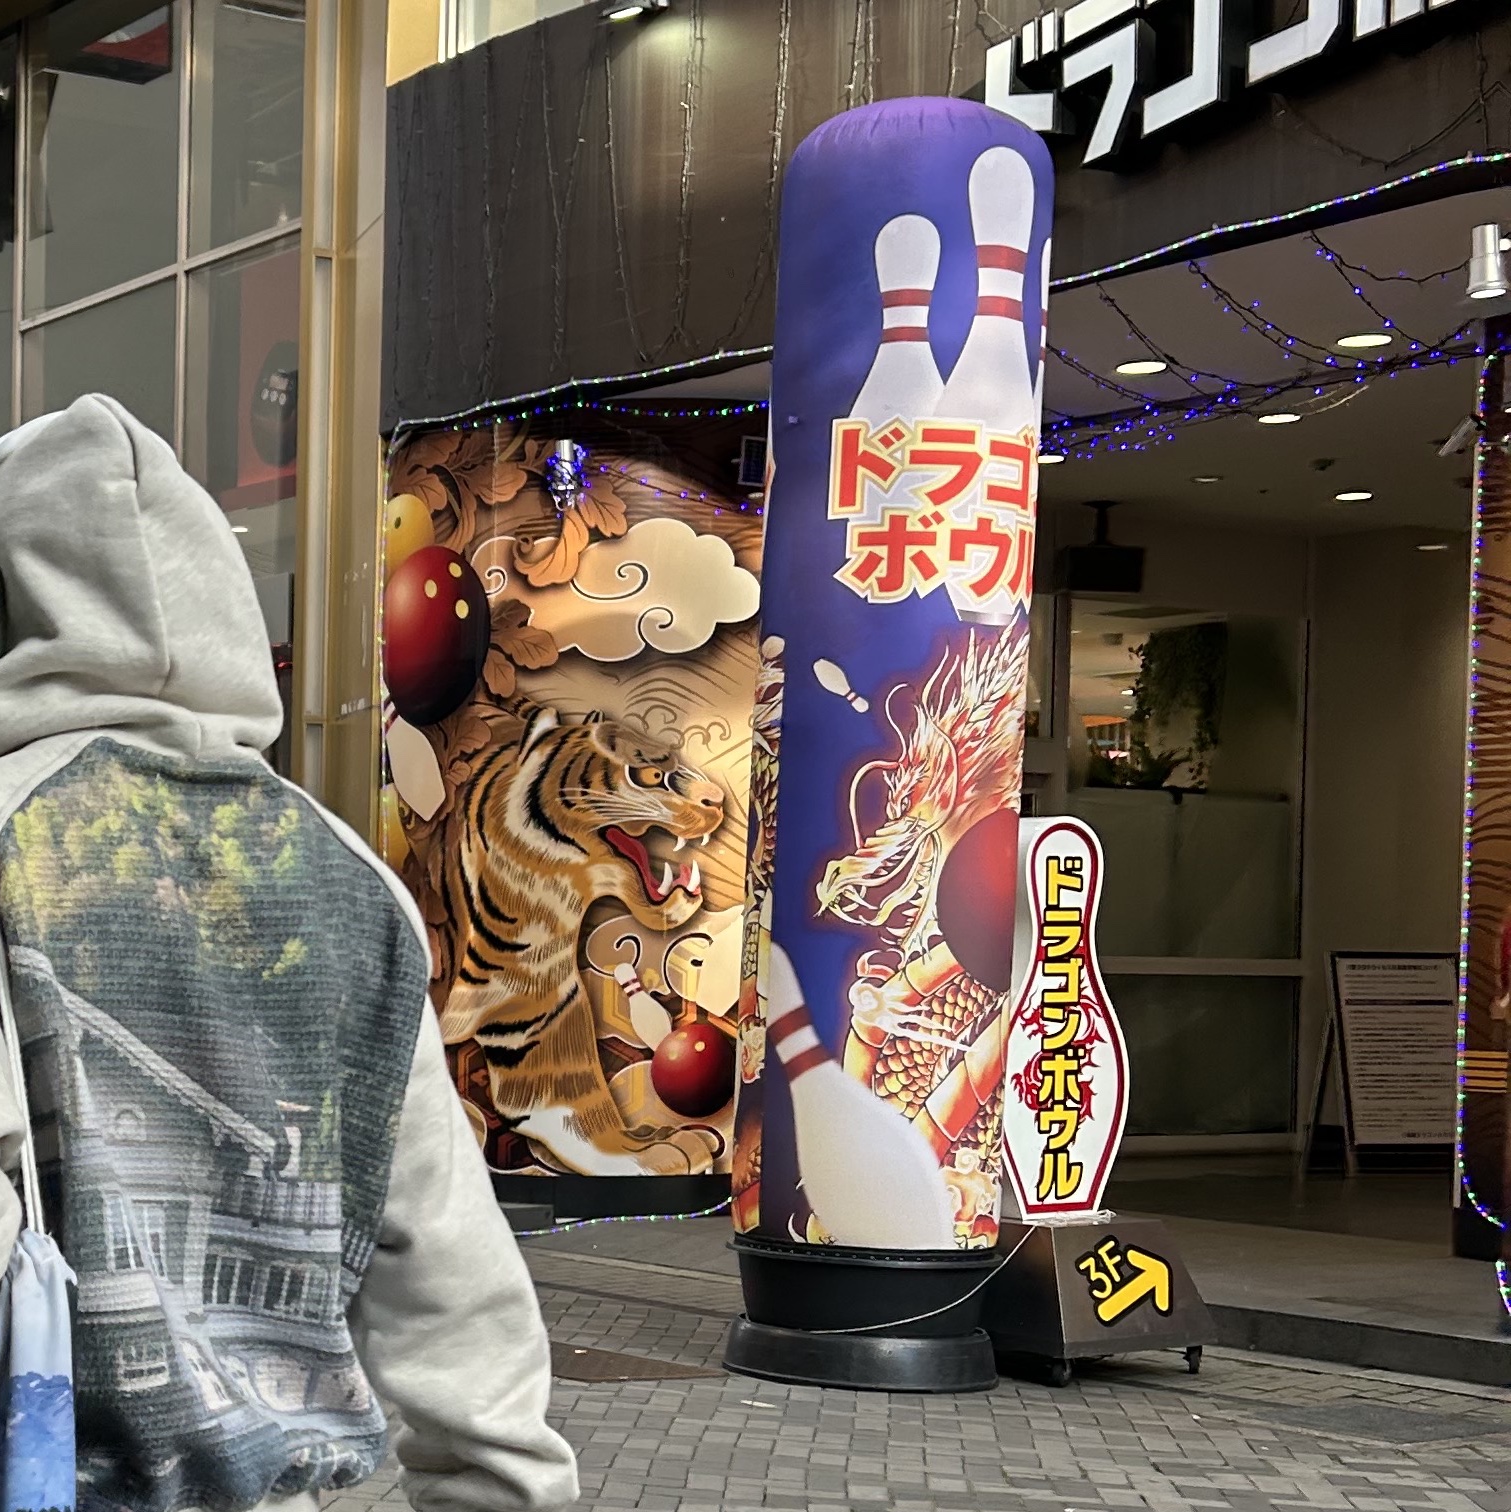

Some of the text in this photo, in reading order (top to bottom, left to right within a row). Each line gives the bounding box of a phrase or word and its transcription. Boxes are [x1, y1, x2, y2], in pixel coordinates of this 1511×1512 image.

[1037, 855, 1086, 1201] ドラゴンボウル
[1078, 1240, 1125, 1299] 3F
